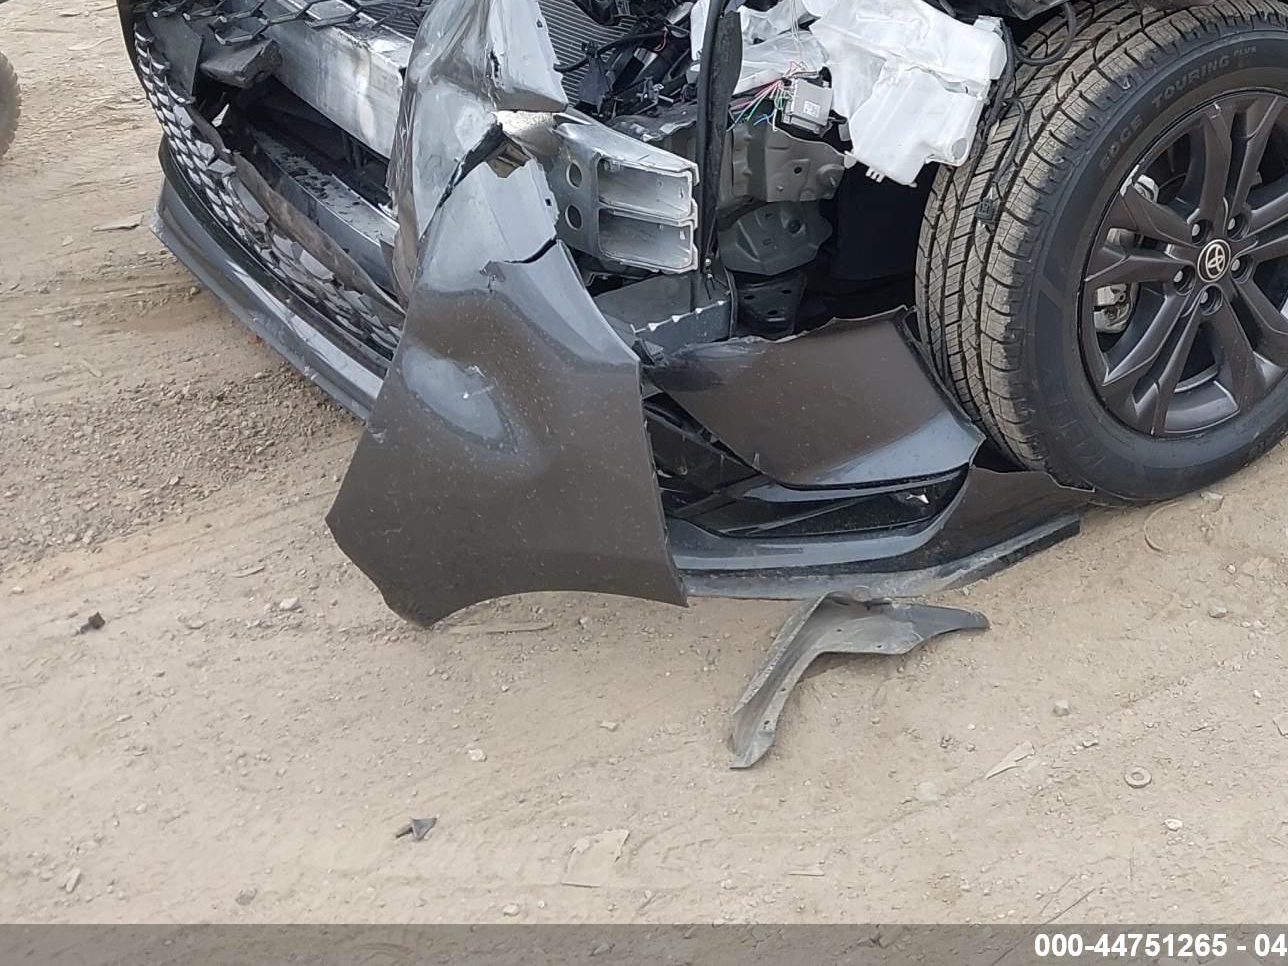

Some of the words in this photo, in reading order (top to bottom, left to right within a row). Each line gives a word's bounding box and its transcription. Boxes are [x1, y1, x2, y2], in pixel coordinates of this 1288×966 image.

[1099, 114, 1144, 172] EDGE
[1151, 54, 1231, 110] TOURING
[1233, 45, 1258, 58] PLUS
